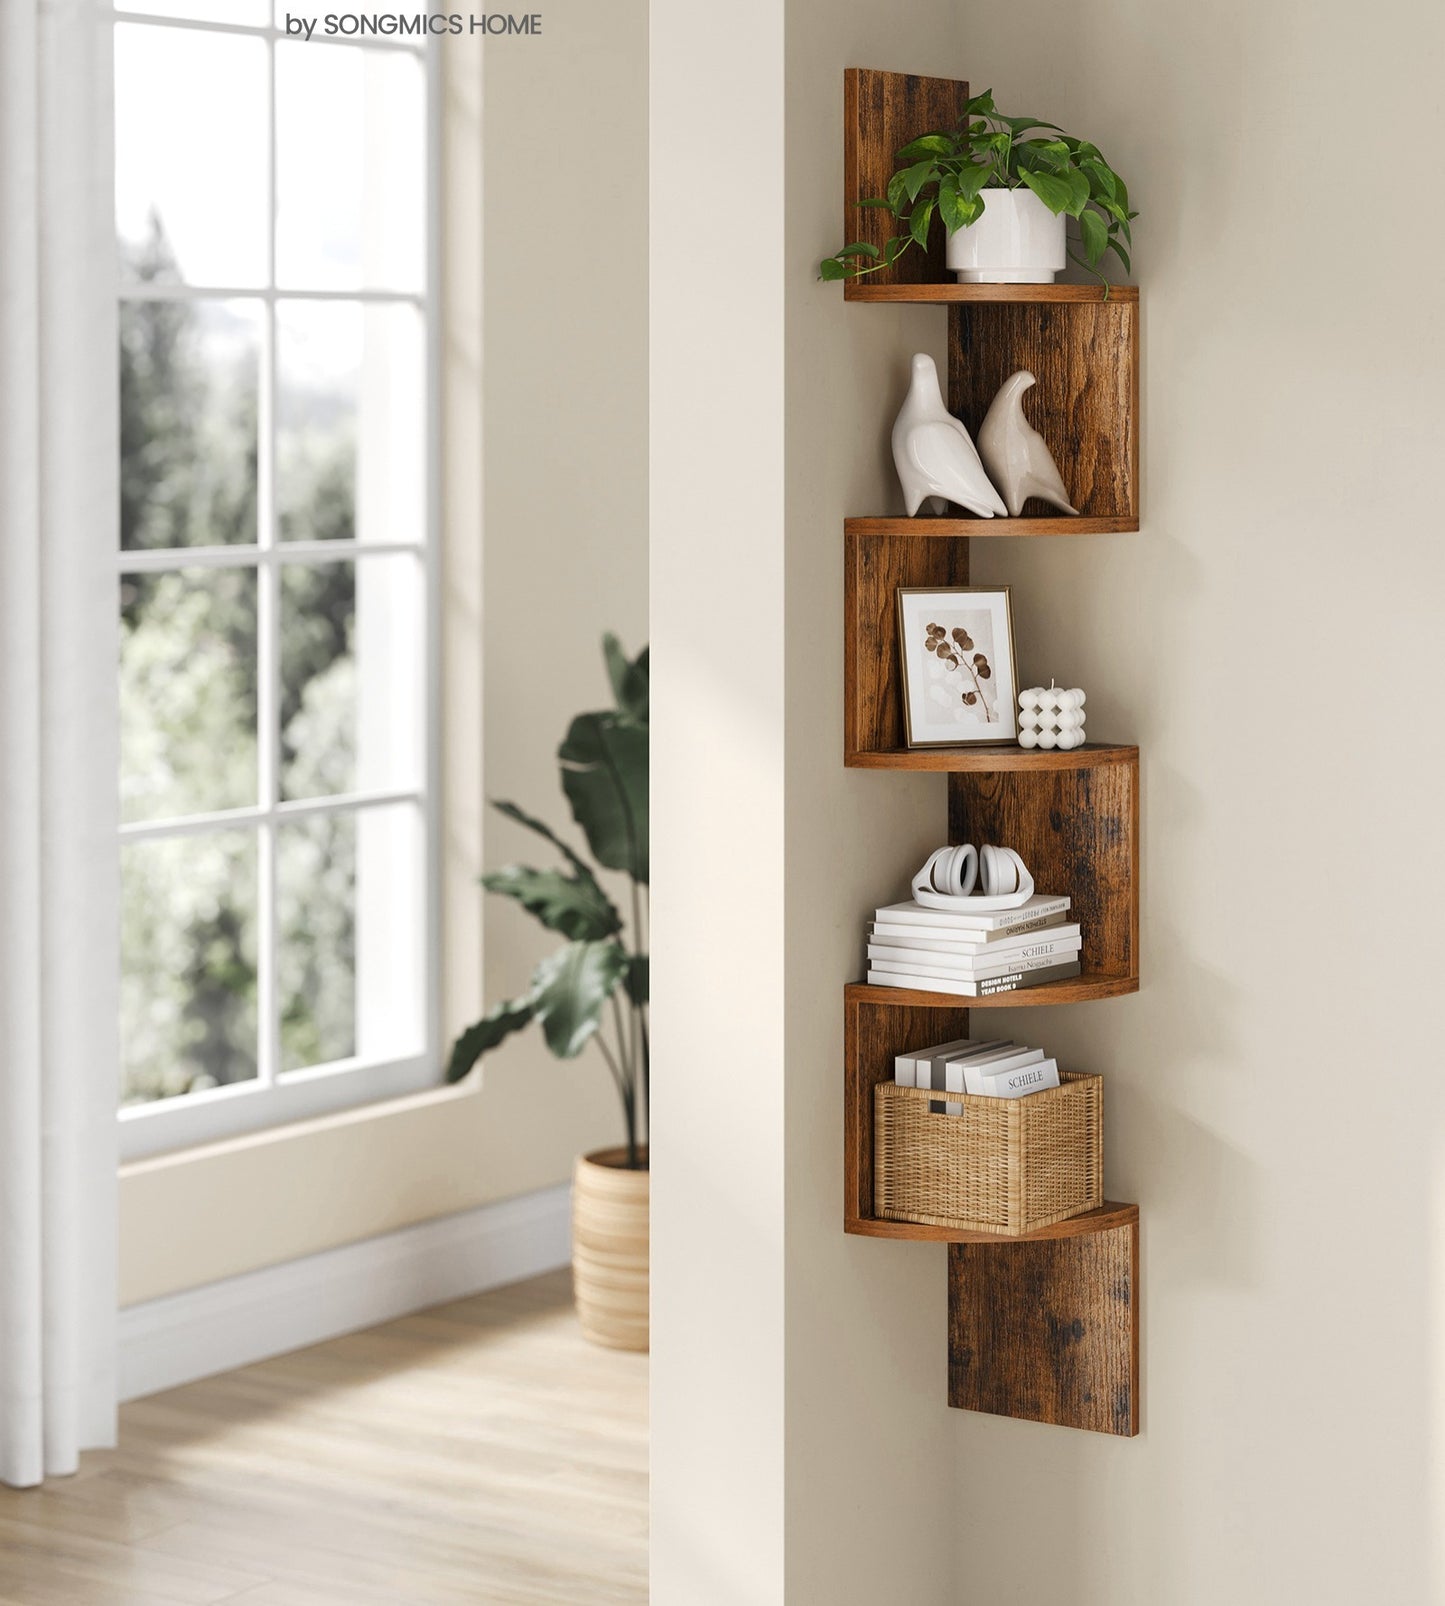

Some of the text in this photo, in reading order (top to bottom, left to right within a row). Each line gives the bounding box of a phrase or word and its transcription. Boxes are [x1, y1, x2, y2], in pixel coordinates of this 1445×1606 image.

[1022, 944, 1054, 958] SCHIELE
[981, 974, 1022, 988] DESIGN HOTELS
[981, 986, 996, 996] YEAR
[996, 984, 1012, 993] BOOK
[1008, 1070, 1044, 1090] SCHIELE
